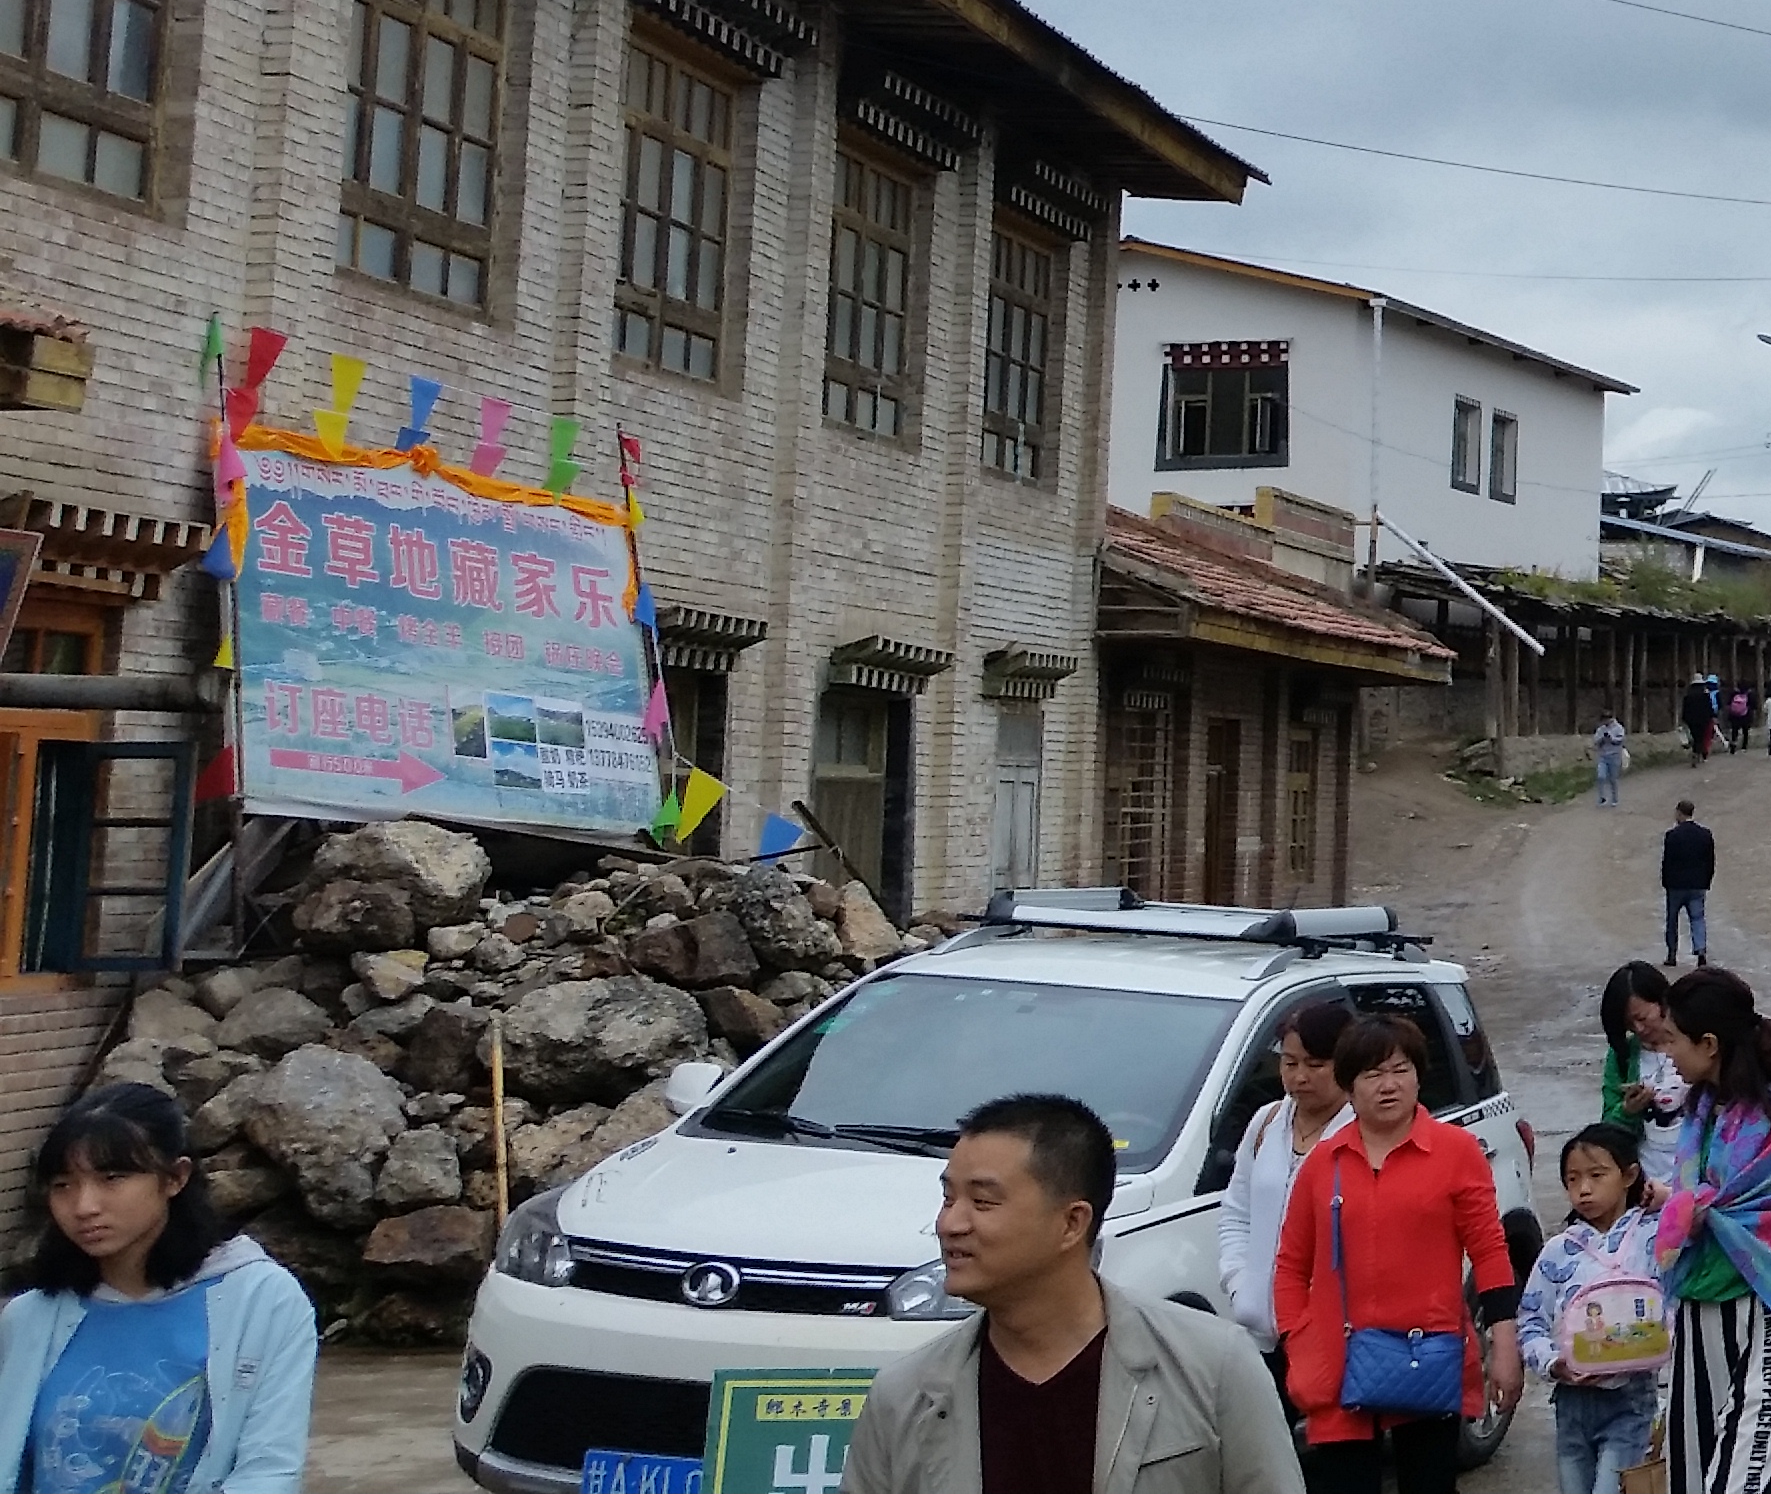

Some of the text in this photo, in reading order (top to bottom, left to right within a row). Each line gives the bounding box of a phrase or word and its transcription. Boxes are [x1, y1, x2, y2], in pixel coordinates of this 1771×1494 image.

[254, 500, 618, 628] 金草地藏家乐
[264, 679, 434, 749] 订座电话
